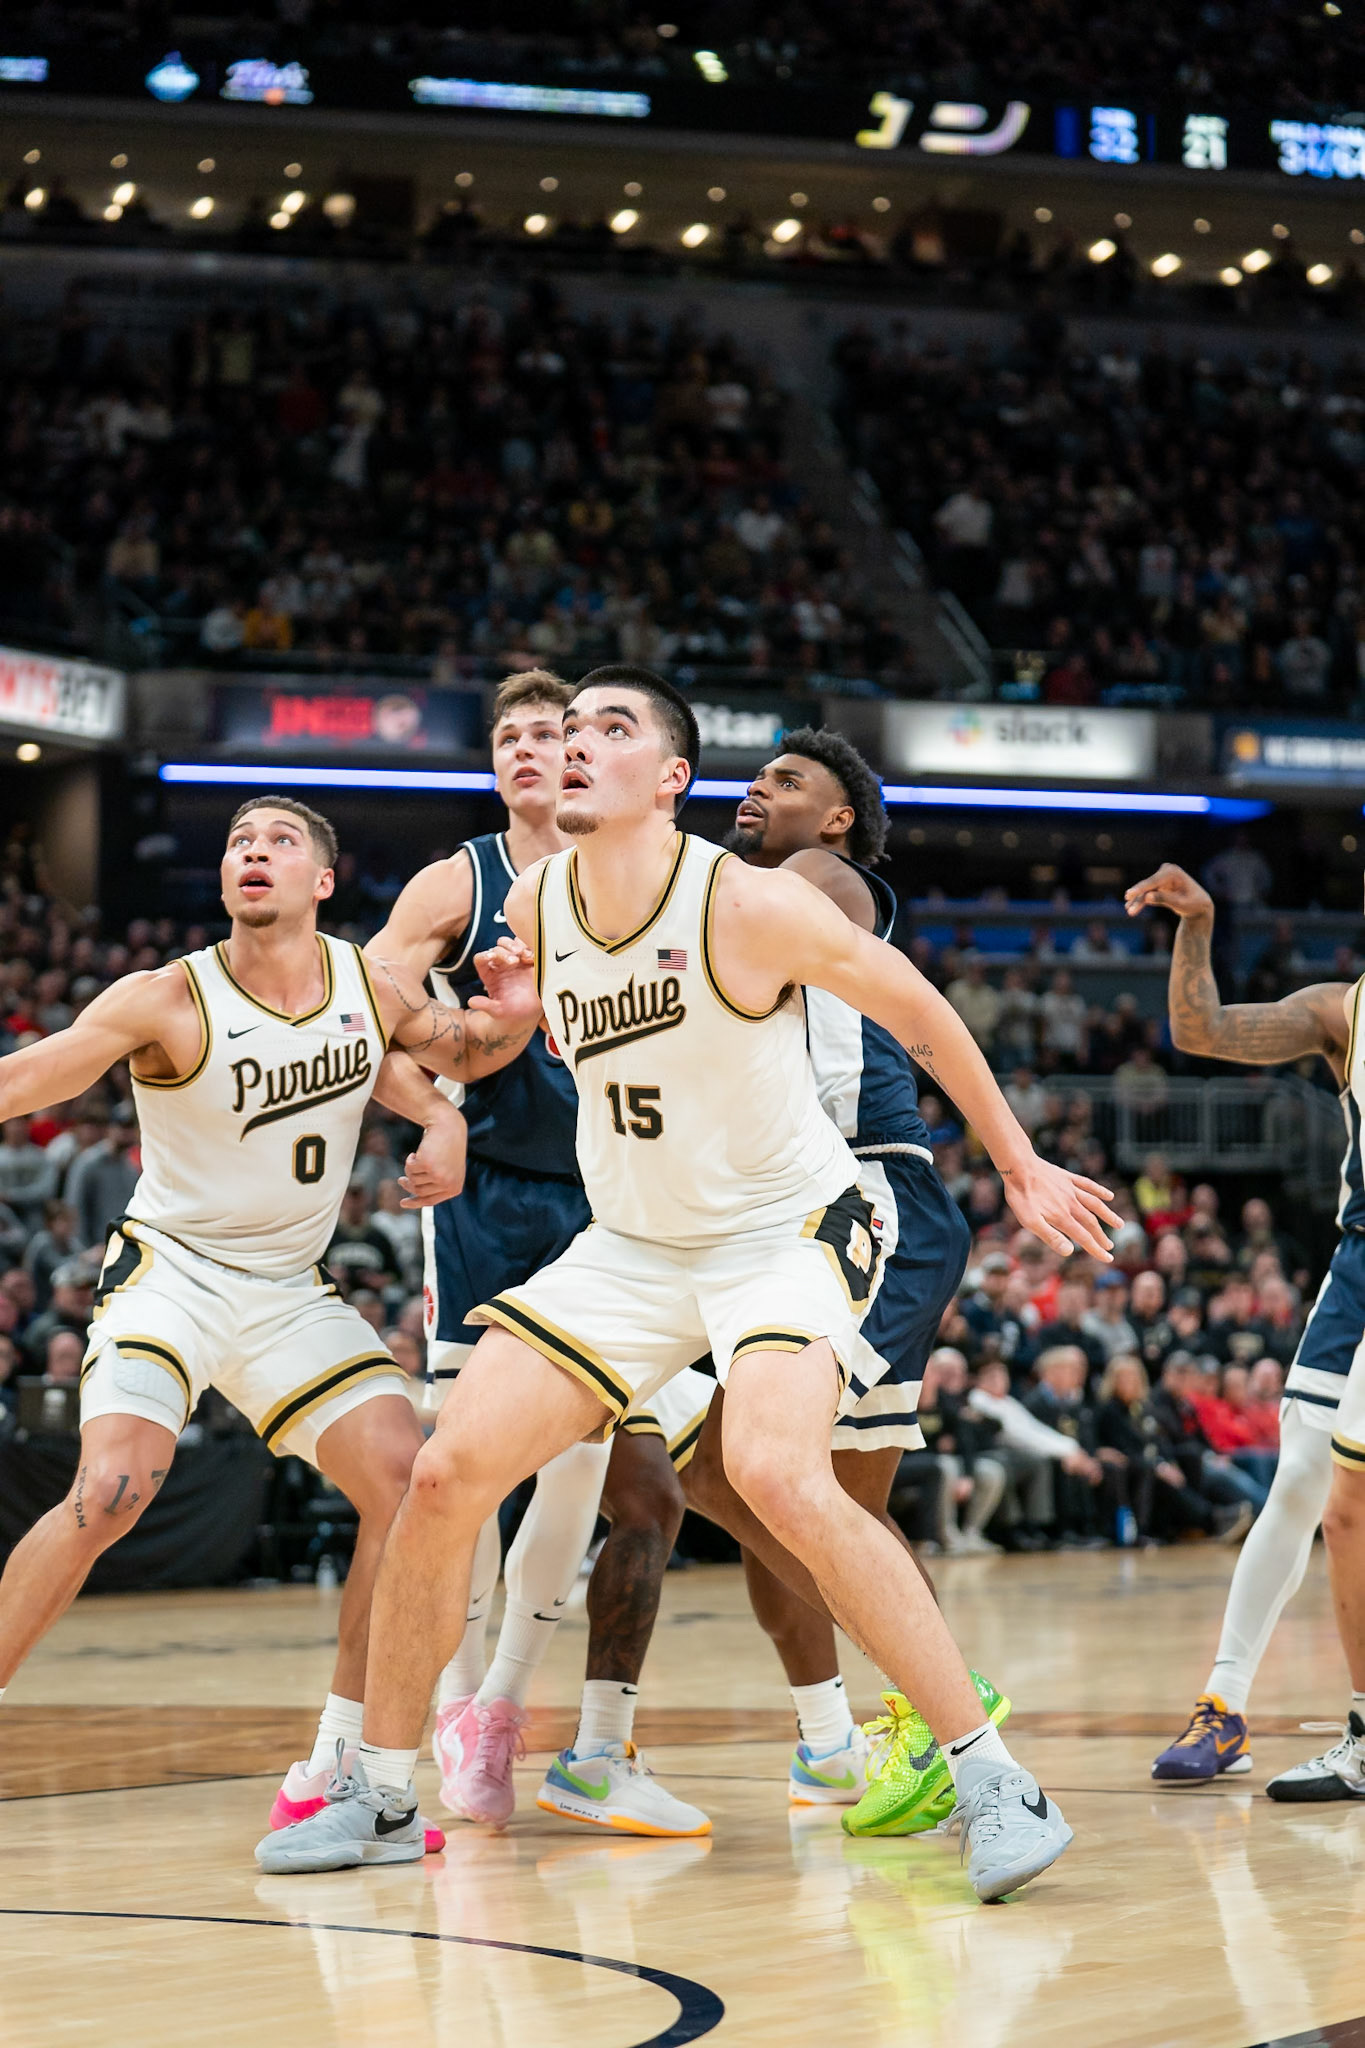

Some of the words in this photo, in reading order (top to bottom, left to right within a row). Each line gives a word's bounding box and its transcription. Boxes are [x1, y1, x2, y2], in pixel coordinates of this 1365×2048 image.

[1184, 132, 1227, 170] 21
[995, 708, 1087, 746] slack
[556, 973, 687, 1046] Purdue
[229, 1038, 371, 1113] Purdue
[604, 1081, 664, 1140] 15
[292, 1133, 327, 1185] 0
